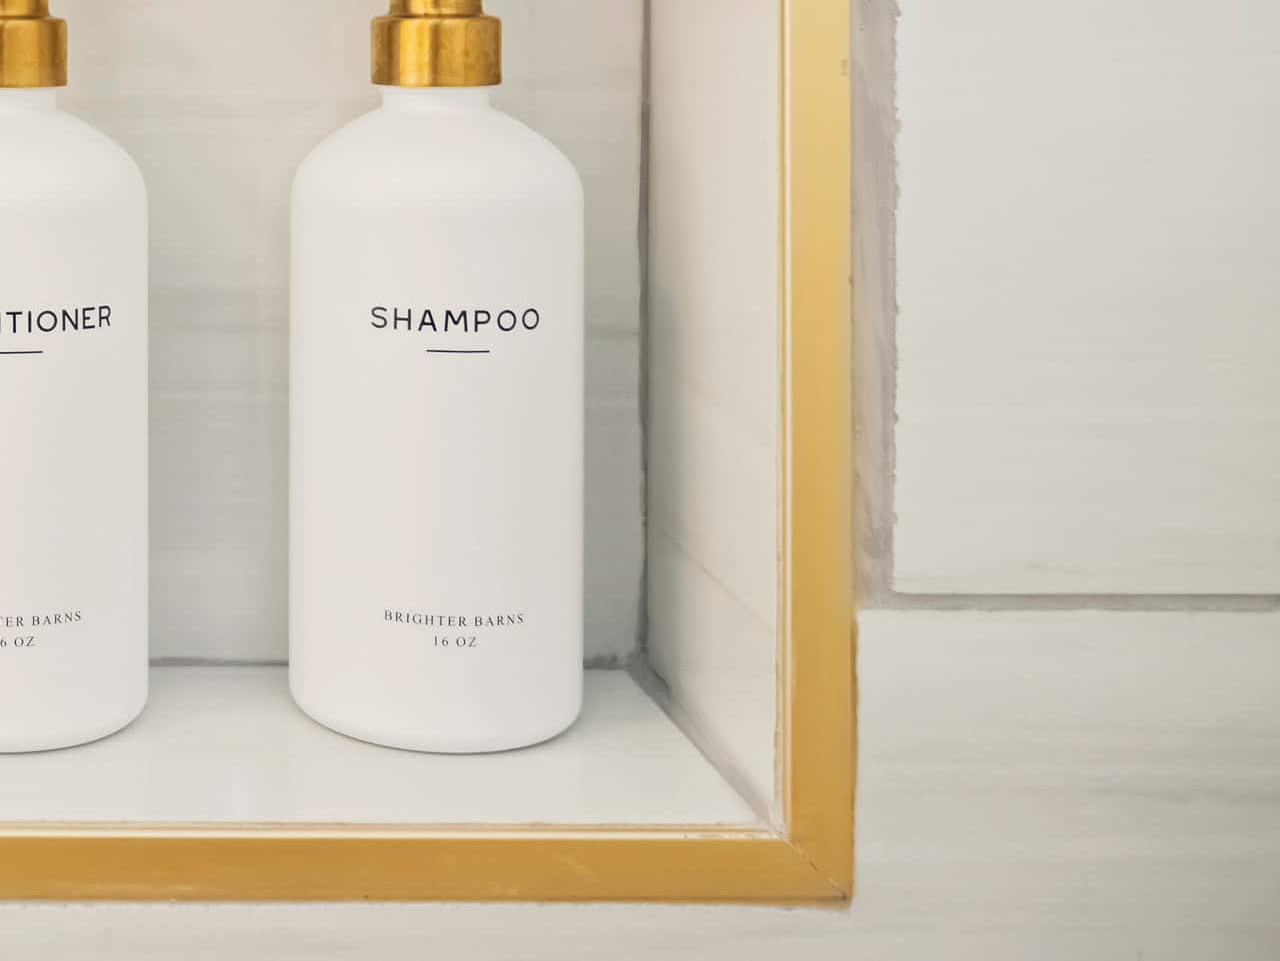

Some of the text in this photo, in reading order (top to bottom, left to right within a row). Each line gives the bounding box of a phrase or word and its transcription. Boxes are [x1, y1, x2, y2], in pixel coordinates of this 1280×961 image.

[370, 305, 540, 334] SHAMPOO
[31, 610, 82, 627] BARNS
[384, 609, 524, 628] BRIGHTER BARNS
[13, 635, 35, 648] OZ
[434, 635, 477, 648] 16 OZ
